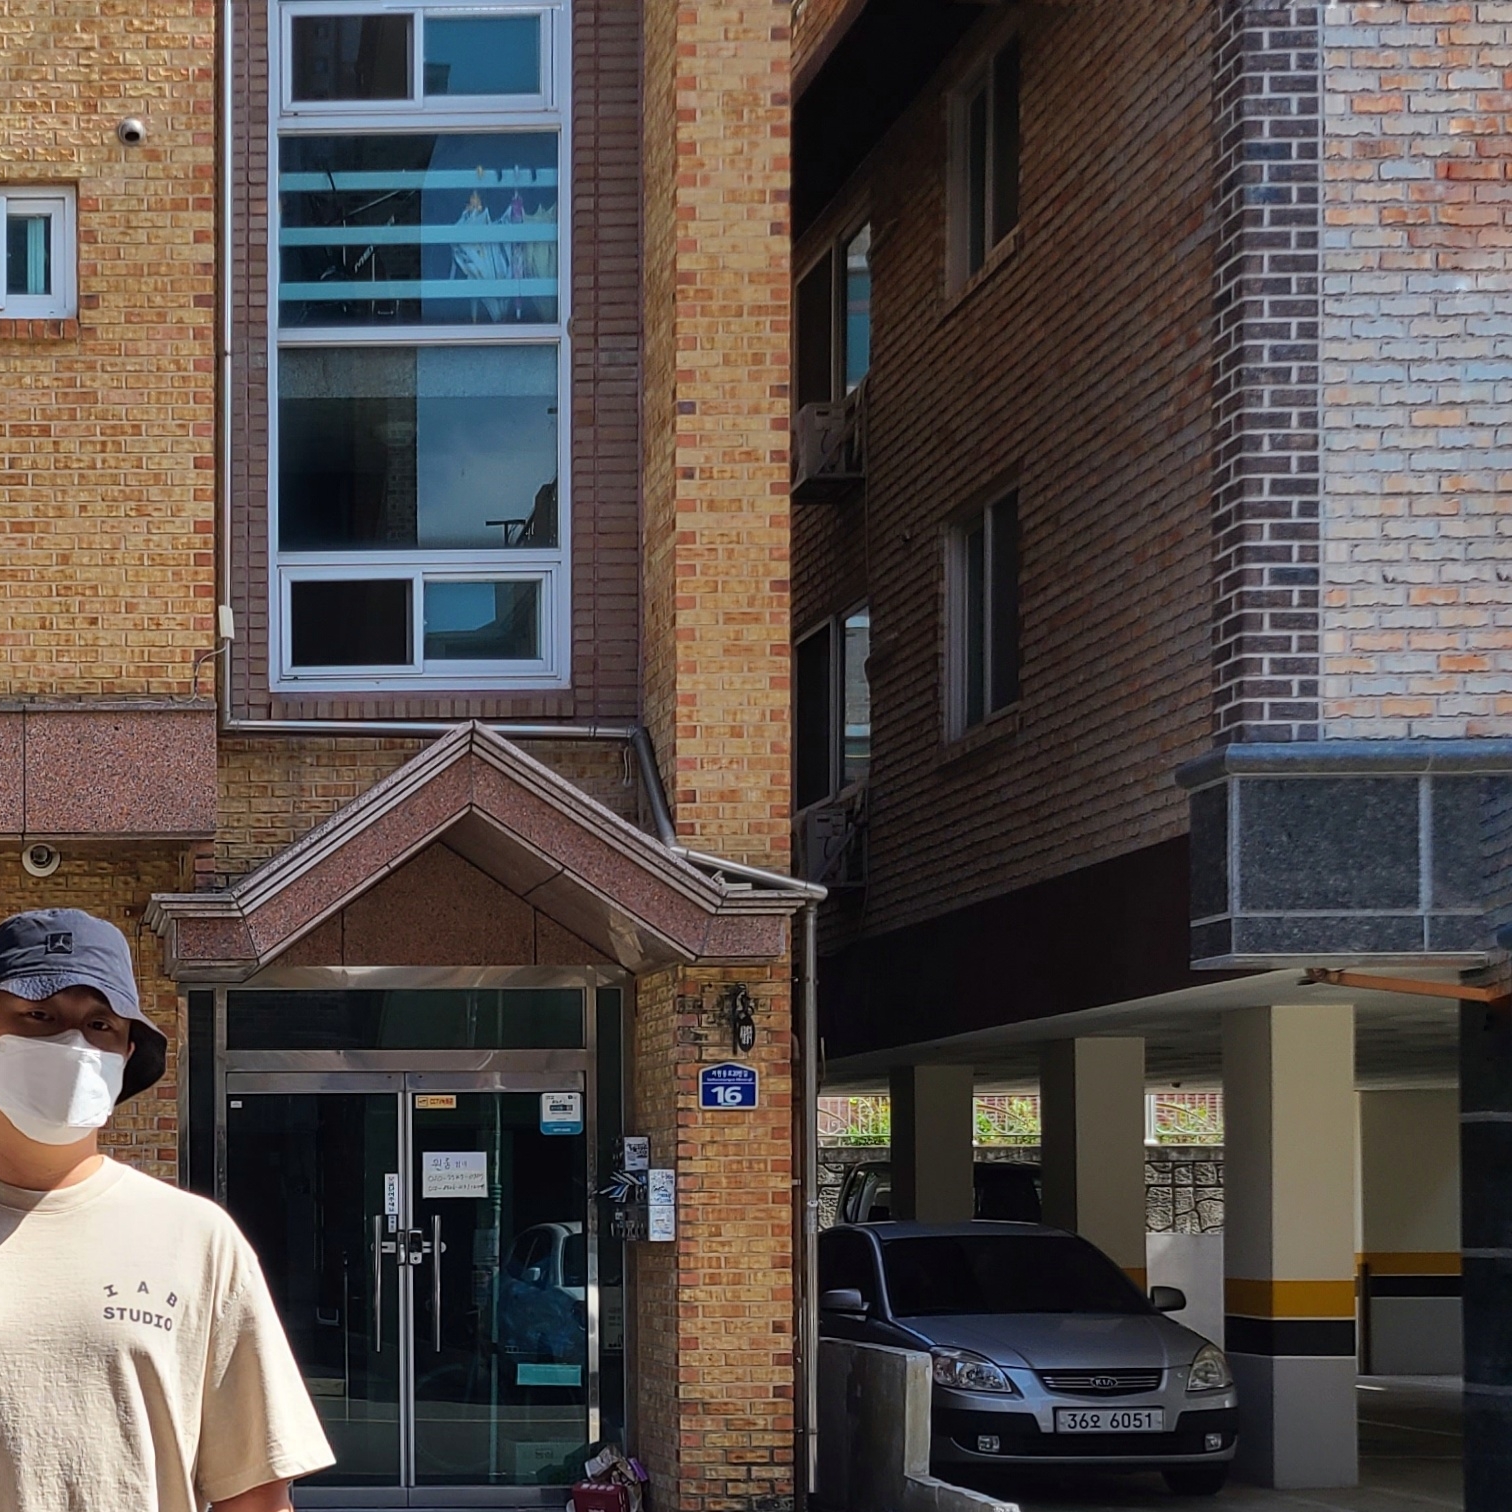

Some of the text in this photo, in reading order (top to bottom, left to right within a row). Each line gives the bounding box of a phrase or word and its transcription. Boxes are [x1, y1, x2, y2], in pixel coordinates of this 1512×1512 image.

[710, 1086, 743, 1104] 16
[103, 1306, 173, 1332] STUDIO
[1094, 1379, 1114, 1387] KIA
[1067, 1412, 1152, 1430] 36오 6051
